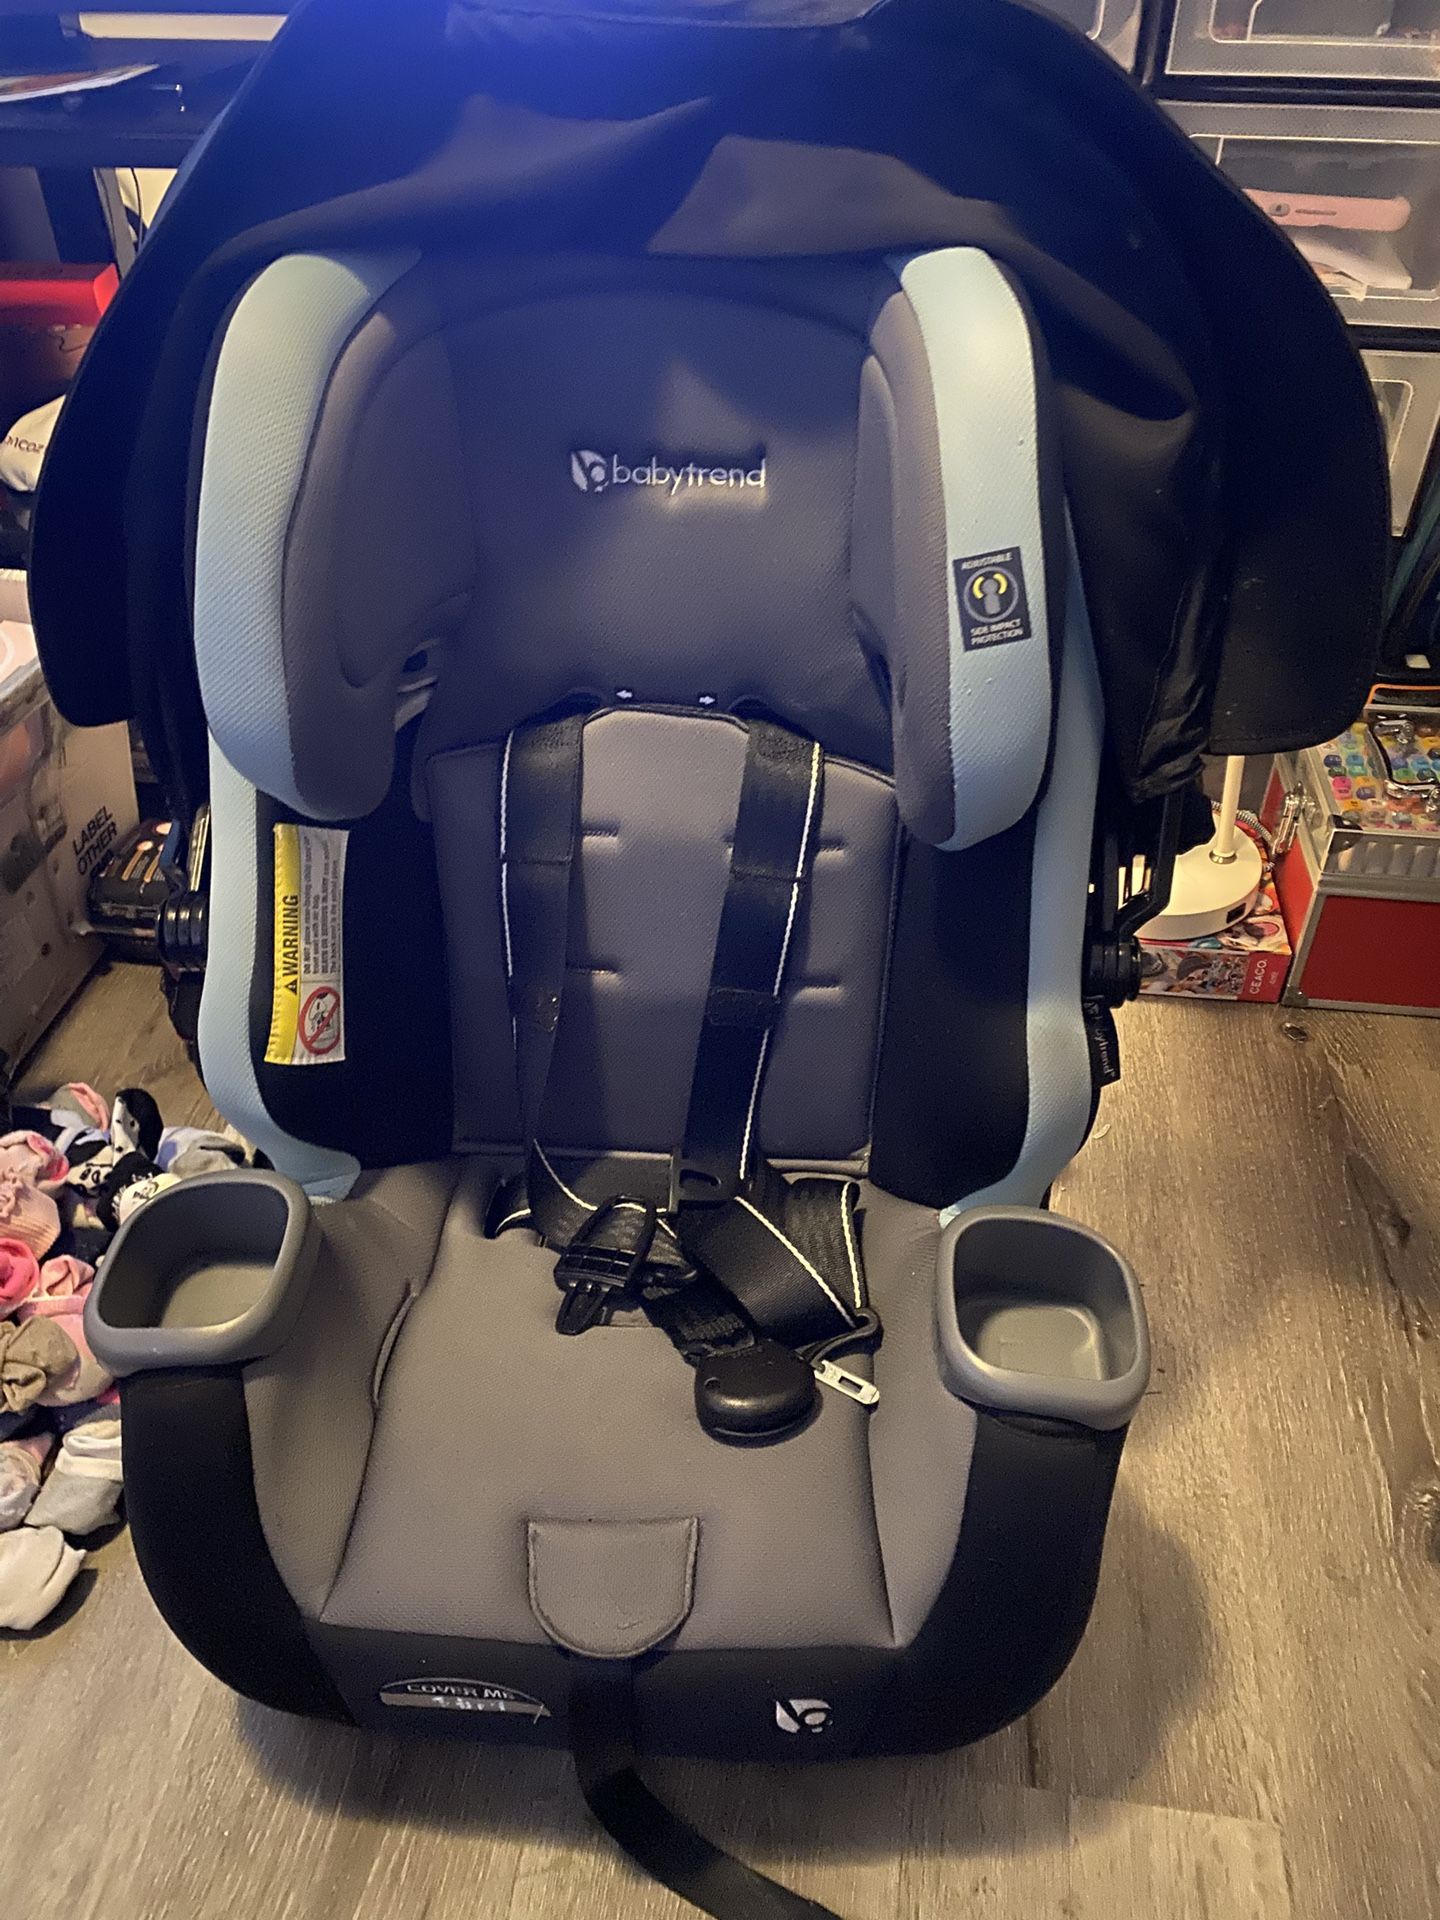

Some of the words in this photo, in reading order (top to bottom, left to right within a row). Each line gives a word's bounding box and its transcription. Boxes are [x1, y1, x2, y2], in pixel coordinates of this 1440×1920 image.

[613, 453, 767, 496] babytrend
[961, 552, 1013, 570] ADJUSTABLE
[970, 625, 988, 637] SIDE
[990, 617, 1021, 632] IMPACT
[970, 627, 1024, 645] PROTECTION
[72, 805, 113, 856] LABEL
[77, 821, 118, 876] OTHER
[282, 894, 299, 977] WARNING
